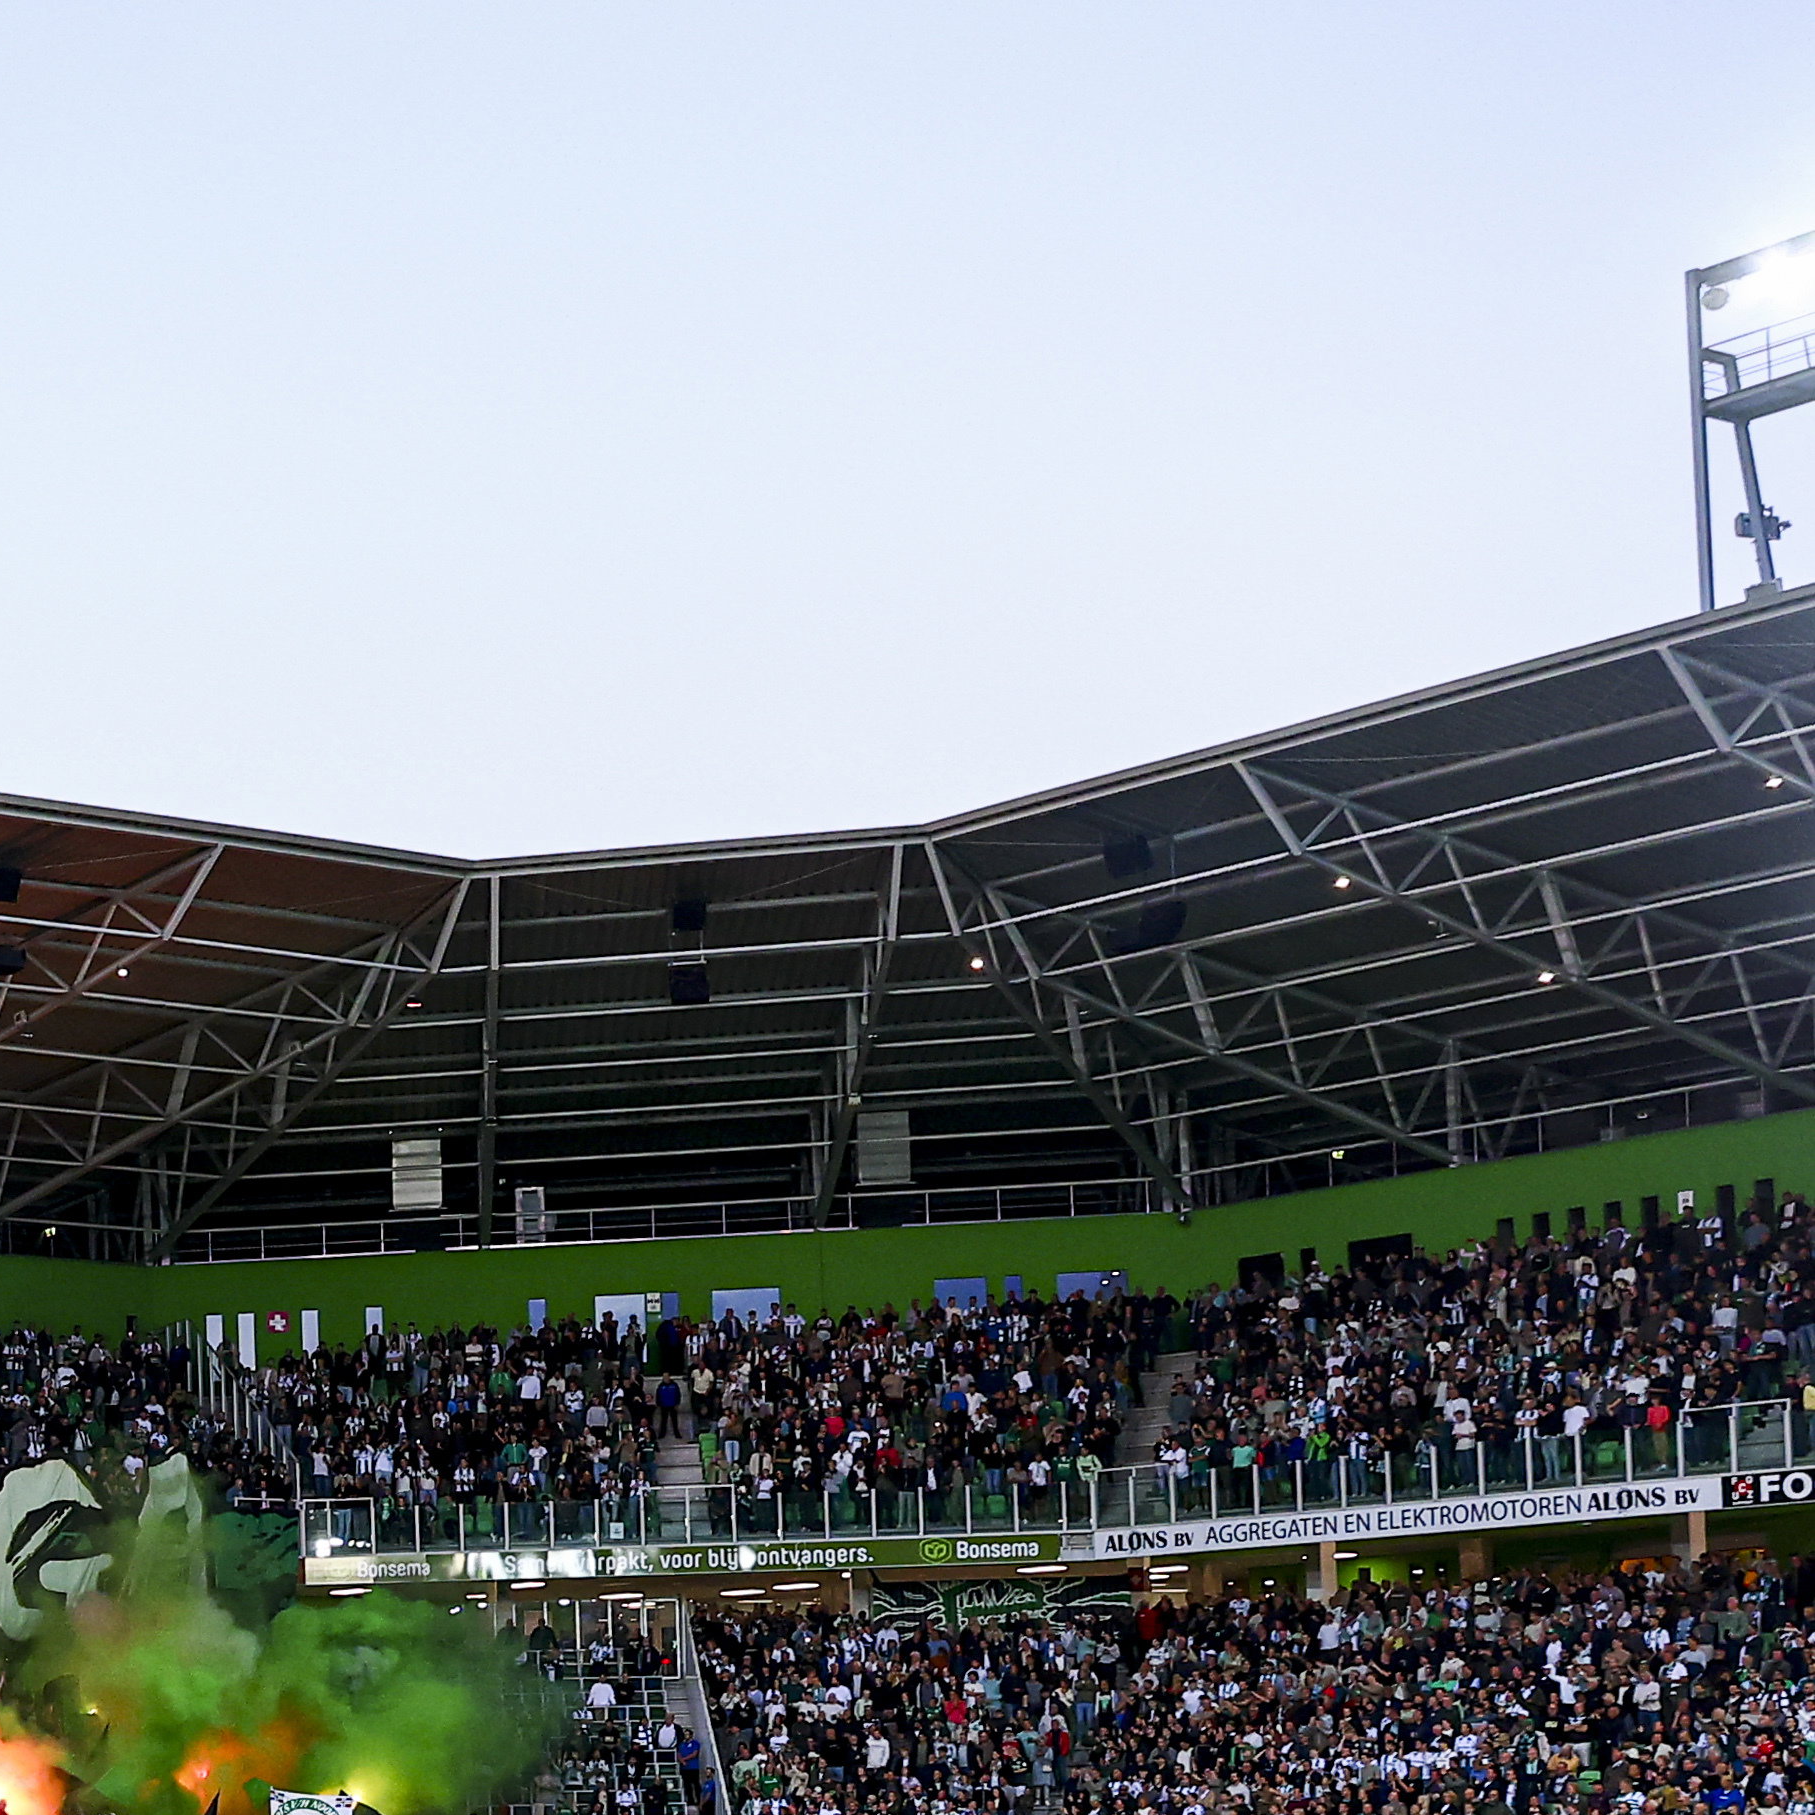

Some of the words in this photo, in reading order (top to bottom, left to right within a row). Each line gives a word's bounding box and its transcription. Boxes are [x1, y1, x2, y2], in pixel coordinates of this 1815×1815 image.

[1105, 1530, 1168, 1554] ALONS
[1174, 1531, 1194, 1547] BV
[1205, 1516, 1338, 1544] AGGREGATEN
[1345, 1512, 1371, 1533] EN
[1377, 1494, 1582, 1531] ELEKTROMOTOREN
[1587, 1486, 1667, 1514] ALONS
[1674, 1488, 1700, 1505] BV
[578, 1550, 654, 1576] vrpakt,
[659, 1552, 703, 1569] voor
[757, 1543, 874, 1571] ontvangers.
[956, 1539, 1040, 1560] Bonsema
[357, 1561, 431, 1578] Bonsema
